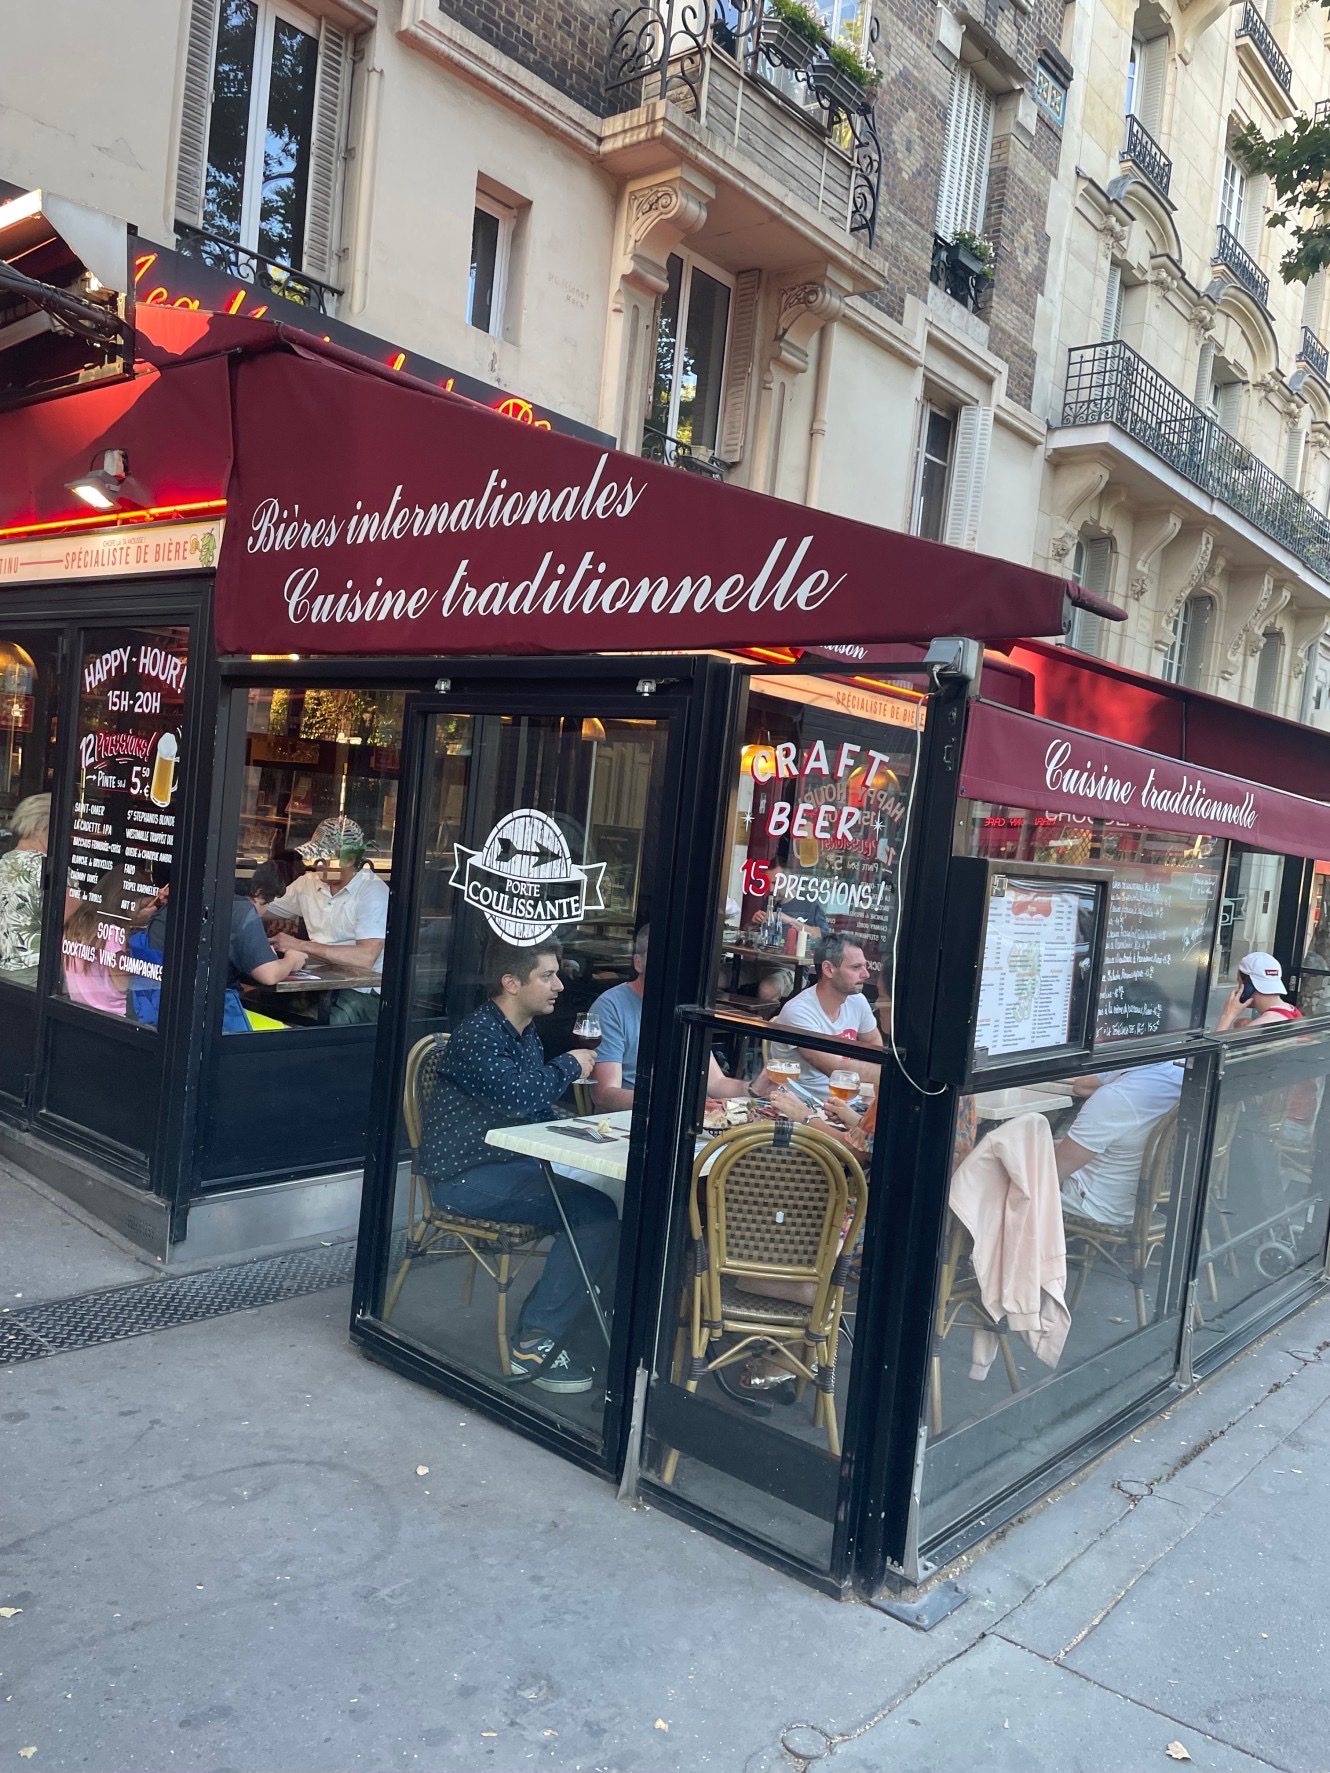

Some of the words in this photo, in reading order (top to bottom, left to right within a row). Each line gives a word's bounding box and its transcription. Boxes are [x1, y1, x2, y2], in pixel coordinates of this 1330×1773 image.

[247, 498, 345, 553] Bières
[346, 453, 647, 546] internationales
[64, 546, 131, 570] SPÉCIALISTE
[135, 544, 149, 564] DE
[154, 538, 189, 562] BIÈRE
[284, 568, 438, 624] Cuisine
[442, 536, 847, 618] traditionnelle
[835, 690, 888, 717] SPÉCIALISTE
[890, 705, 900, 720] DE
[903, 707, 925, 727] BIÈE
[80, 733, 95, 769] 12
[752, 740, 890, 788] CRAFT
[1045, 739, 1137, 804] Cuisine
[1142, 768, 1258, 829] traditionnelle
[102, 824, 112, 835] IPA
[767, 801, 861, 841] BEER
[505, 879, 541, 897] PORTE
[740, 859, 770, 896] 15
[468, 881, 582, 919] COULISSANTE
[97, 922, 126, 945] SOFTS
[62, 940, 96, 962] COCKTAILS
[99, 948, 117, 968] VINS
[119, 955, 163, 982] CHAMPAGNES
